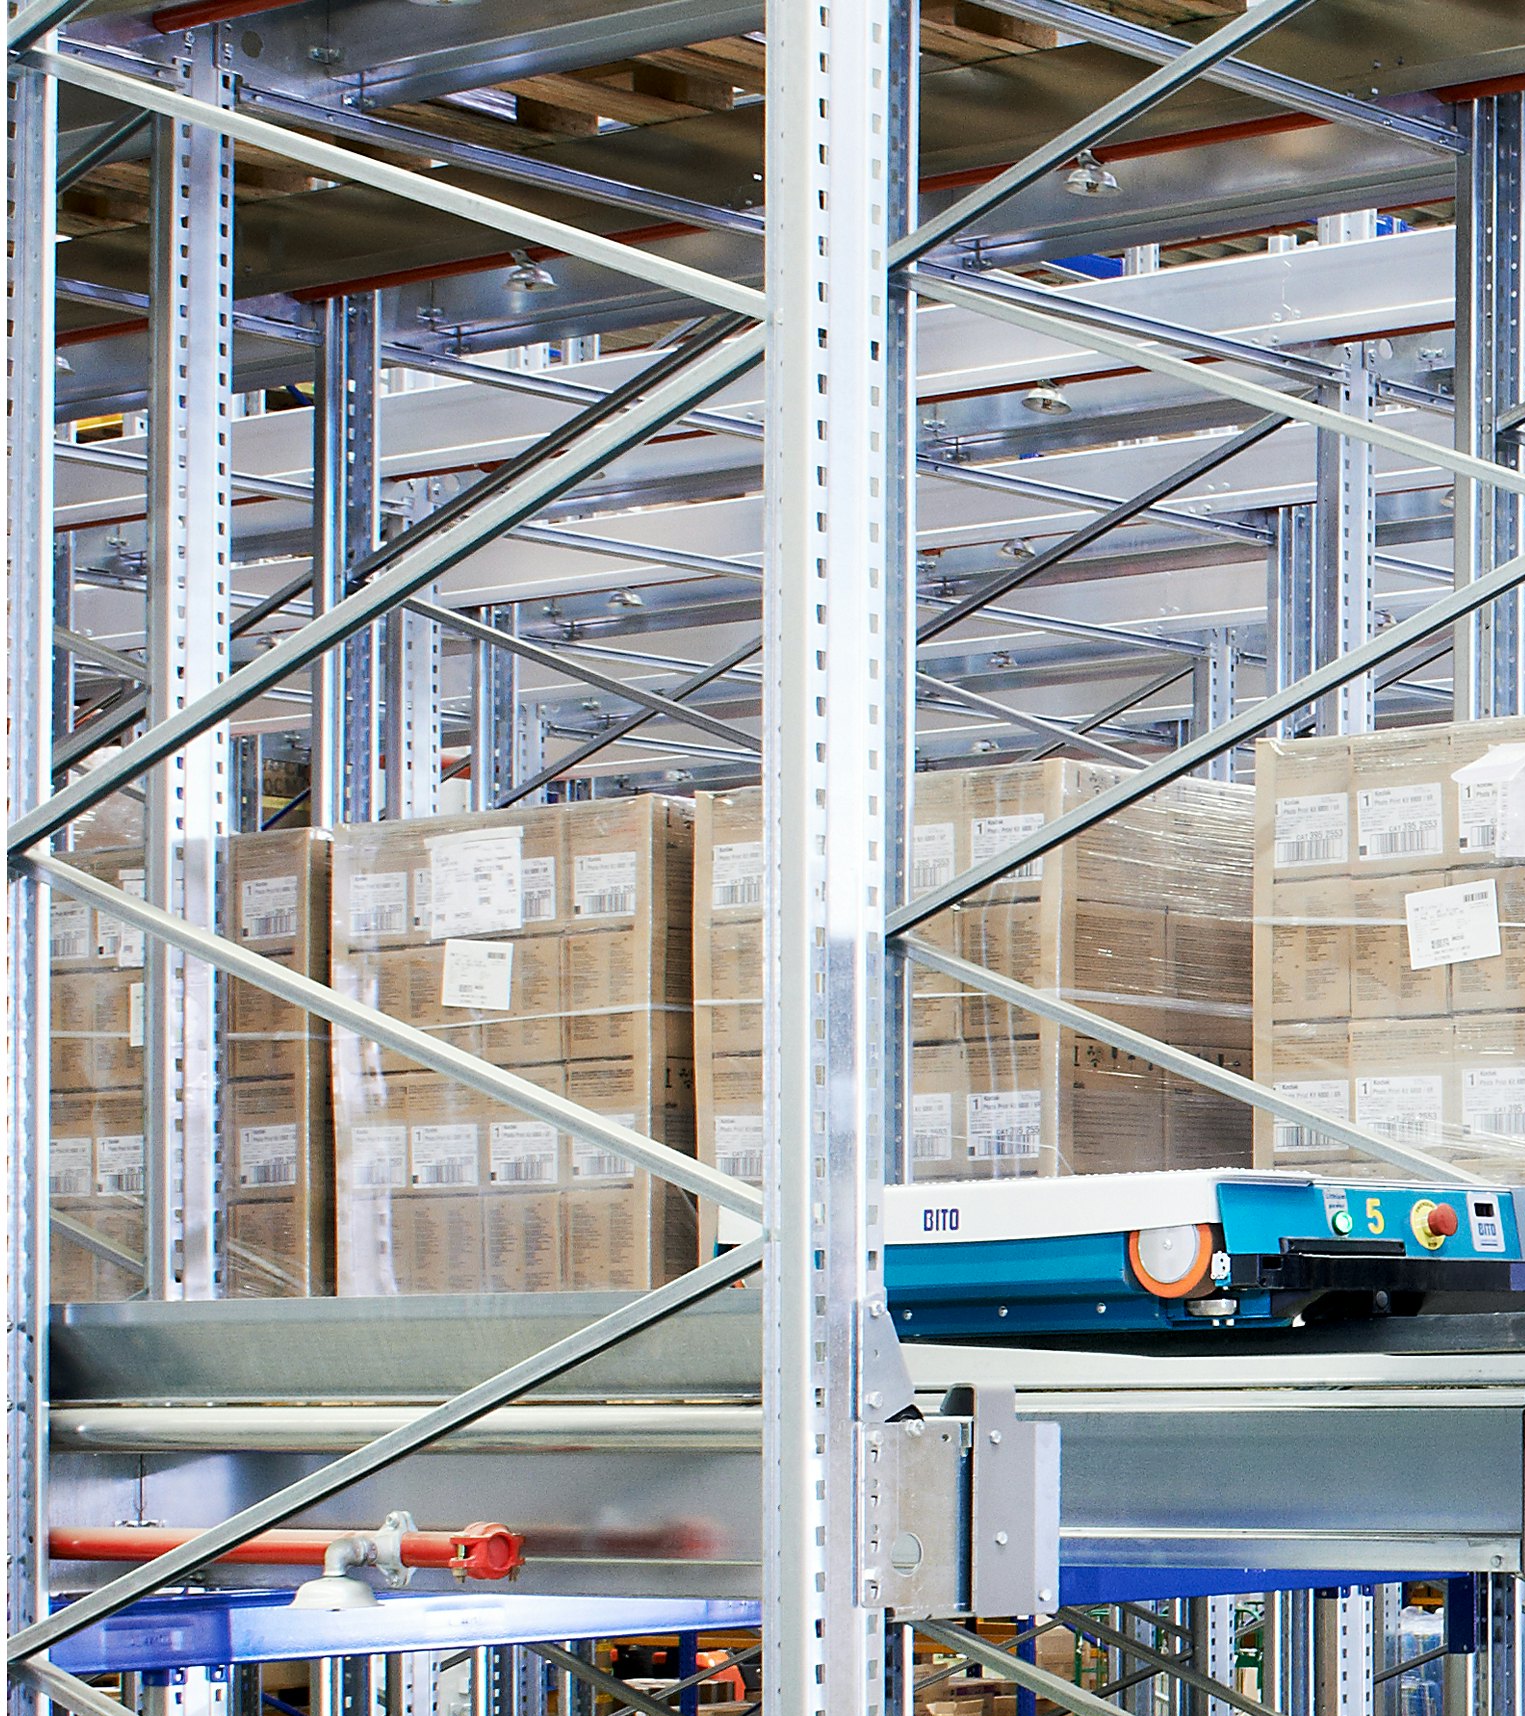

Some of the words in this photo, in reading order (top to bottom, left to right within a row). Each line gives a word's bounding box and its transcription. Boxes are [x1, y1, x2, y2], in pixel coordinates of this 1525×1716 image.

[1465, 785, 1471, 798] 1
[1363, 795, 1370, 806] 1
[977, 823, 984, 834] 1
[1402, 822, 1417, 831] 395
[1419, 820, 1438, 830] 2553
[1309, 831, 1323, 840] 395
[1325, 828, 1344, 839] 2553
[1468, 1073, 1474, 1086] 1
[1363, 1083, 1369, 1095] 1
[973, 1099, 979, 1110] 1
[1508, 1104, 1522, 1113] 395
[244, 1133, 250, 1142] 1
[416, 1131, 421, 1141] 1
[494, 1127, 500, 1138] 1
[924, 1208, 960, 1232] BITO
[1365, 1197, 1385, 1235] 5
[1477, 1222, 1497, 1237] BITO
